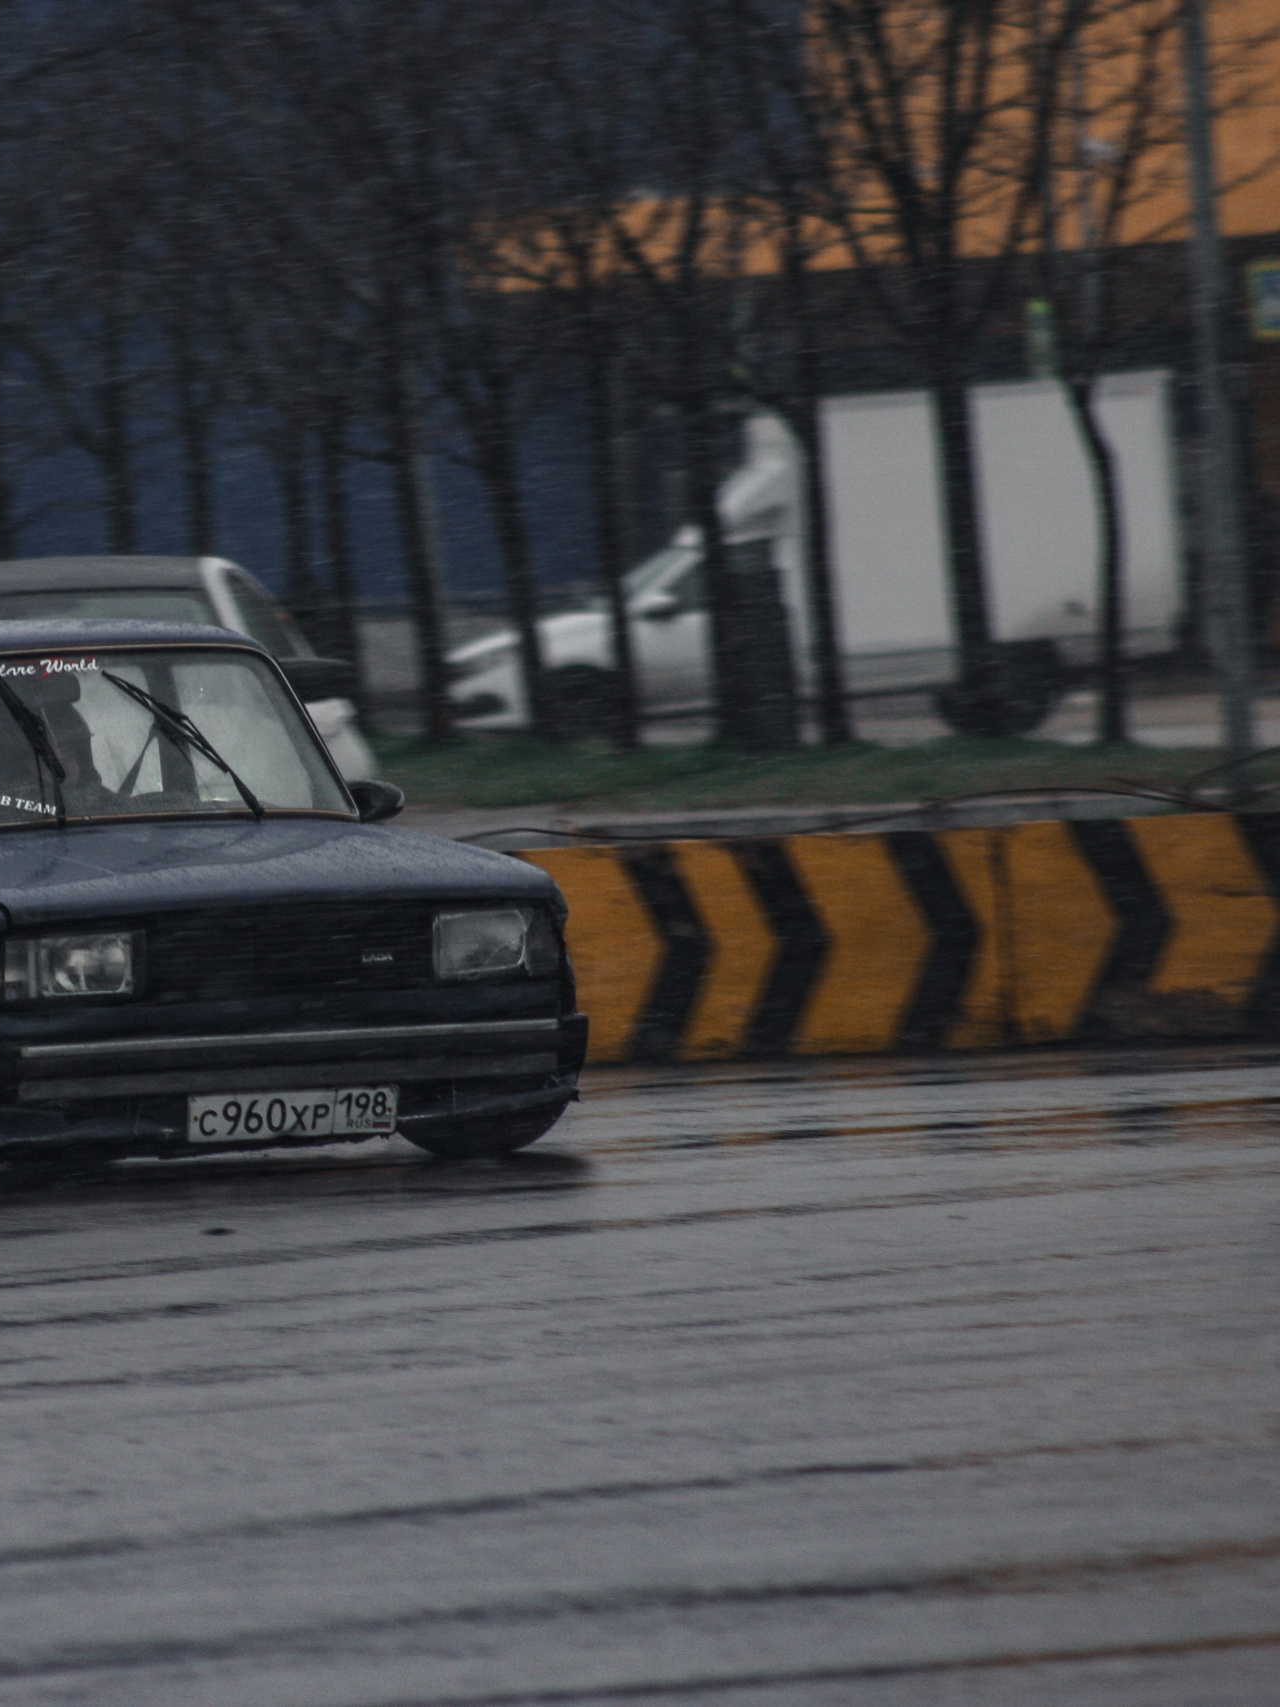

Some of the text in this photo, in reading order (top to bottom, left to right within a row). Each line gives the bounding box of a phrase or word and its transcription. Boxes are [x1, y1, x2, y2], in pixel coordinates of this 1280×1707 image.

[40, 658, 99, 673] World
[15, 797, 58, 816] TEAM
[338, 1091, 388, 1119] 198
[346, 1119, 373, 1129] RUS
